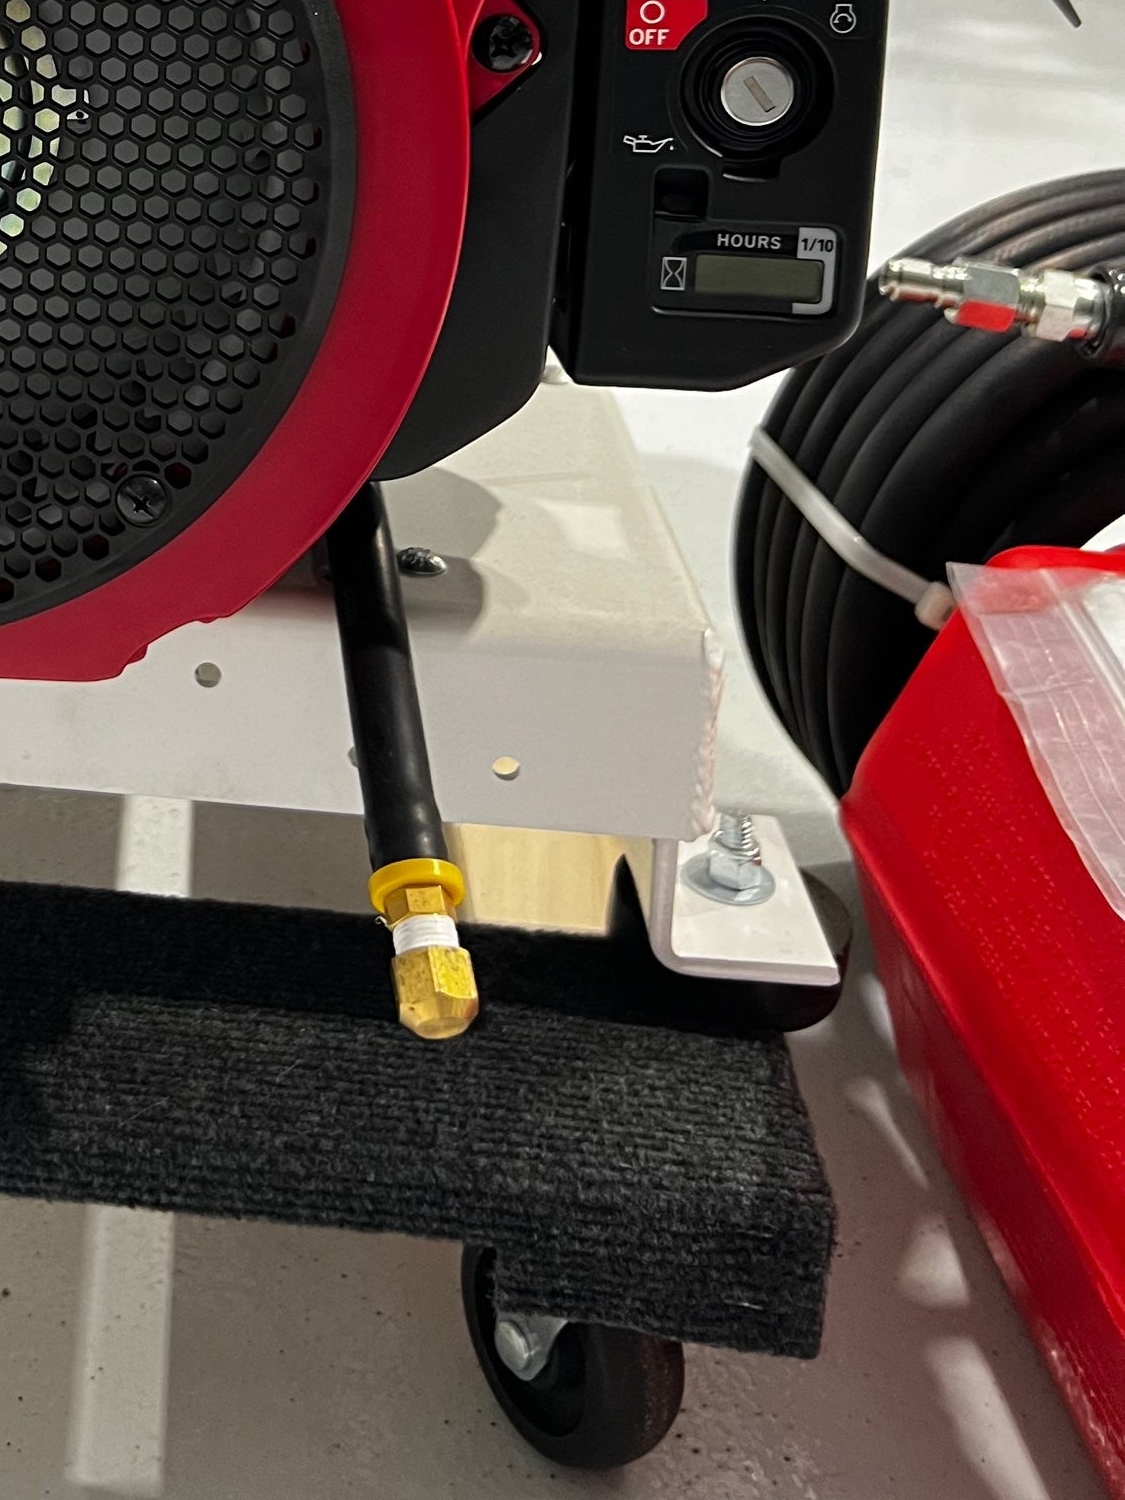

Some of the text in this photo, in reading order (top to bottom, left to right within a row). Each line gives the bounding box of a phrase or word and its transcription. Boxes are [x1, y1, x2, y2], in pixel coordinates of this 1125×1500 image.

[629, 29, 669, 46] OFF
[717, 233, 834, 253] HOURS 1/10
